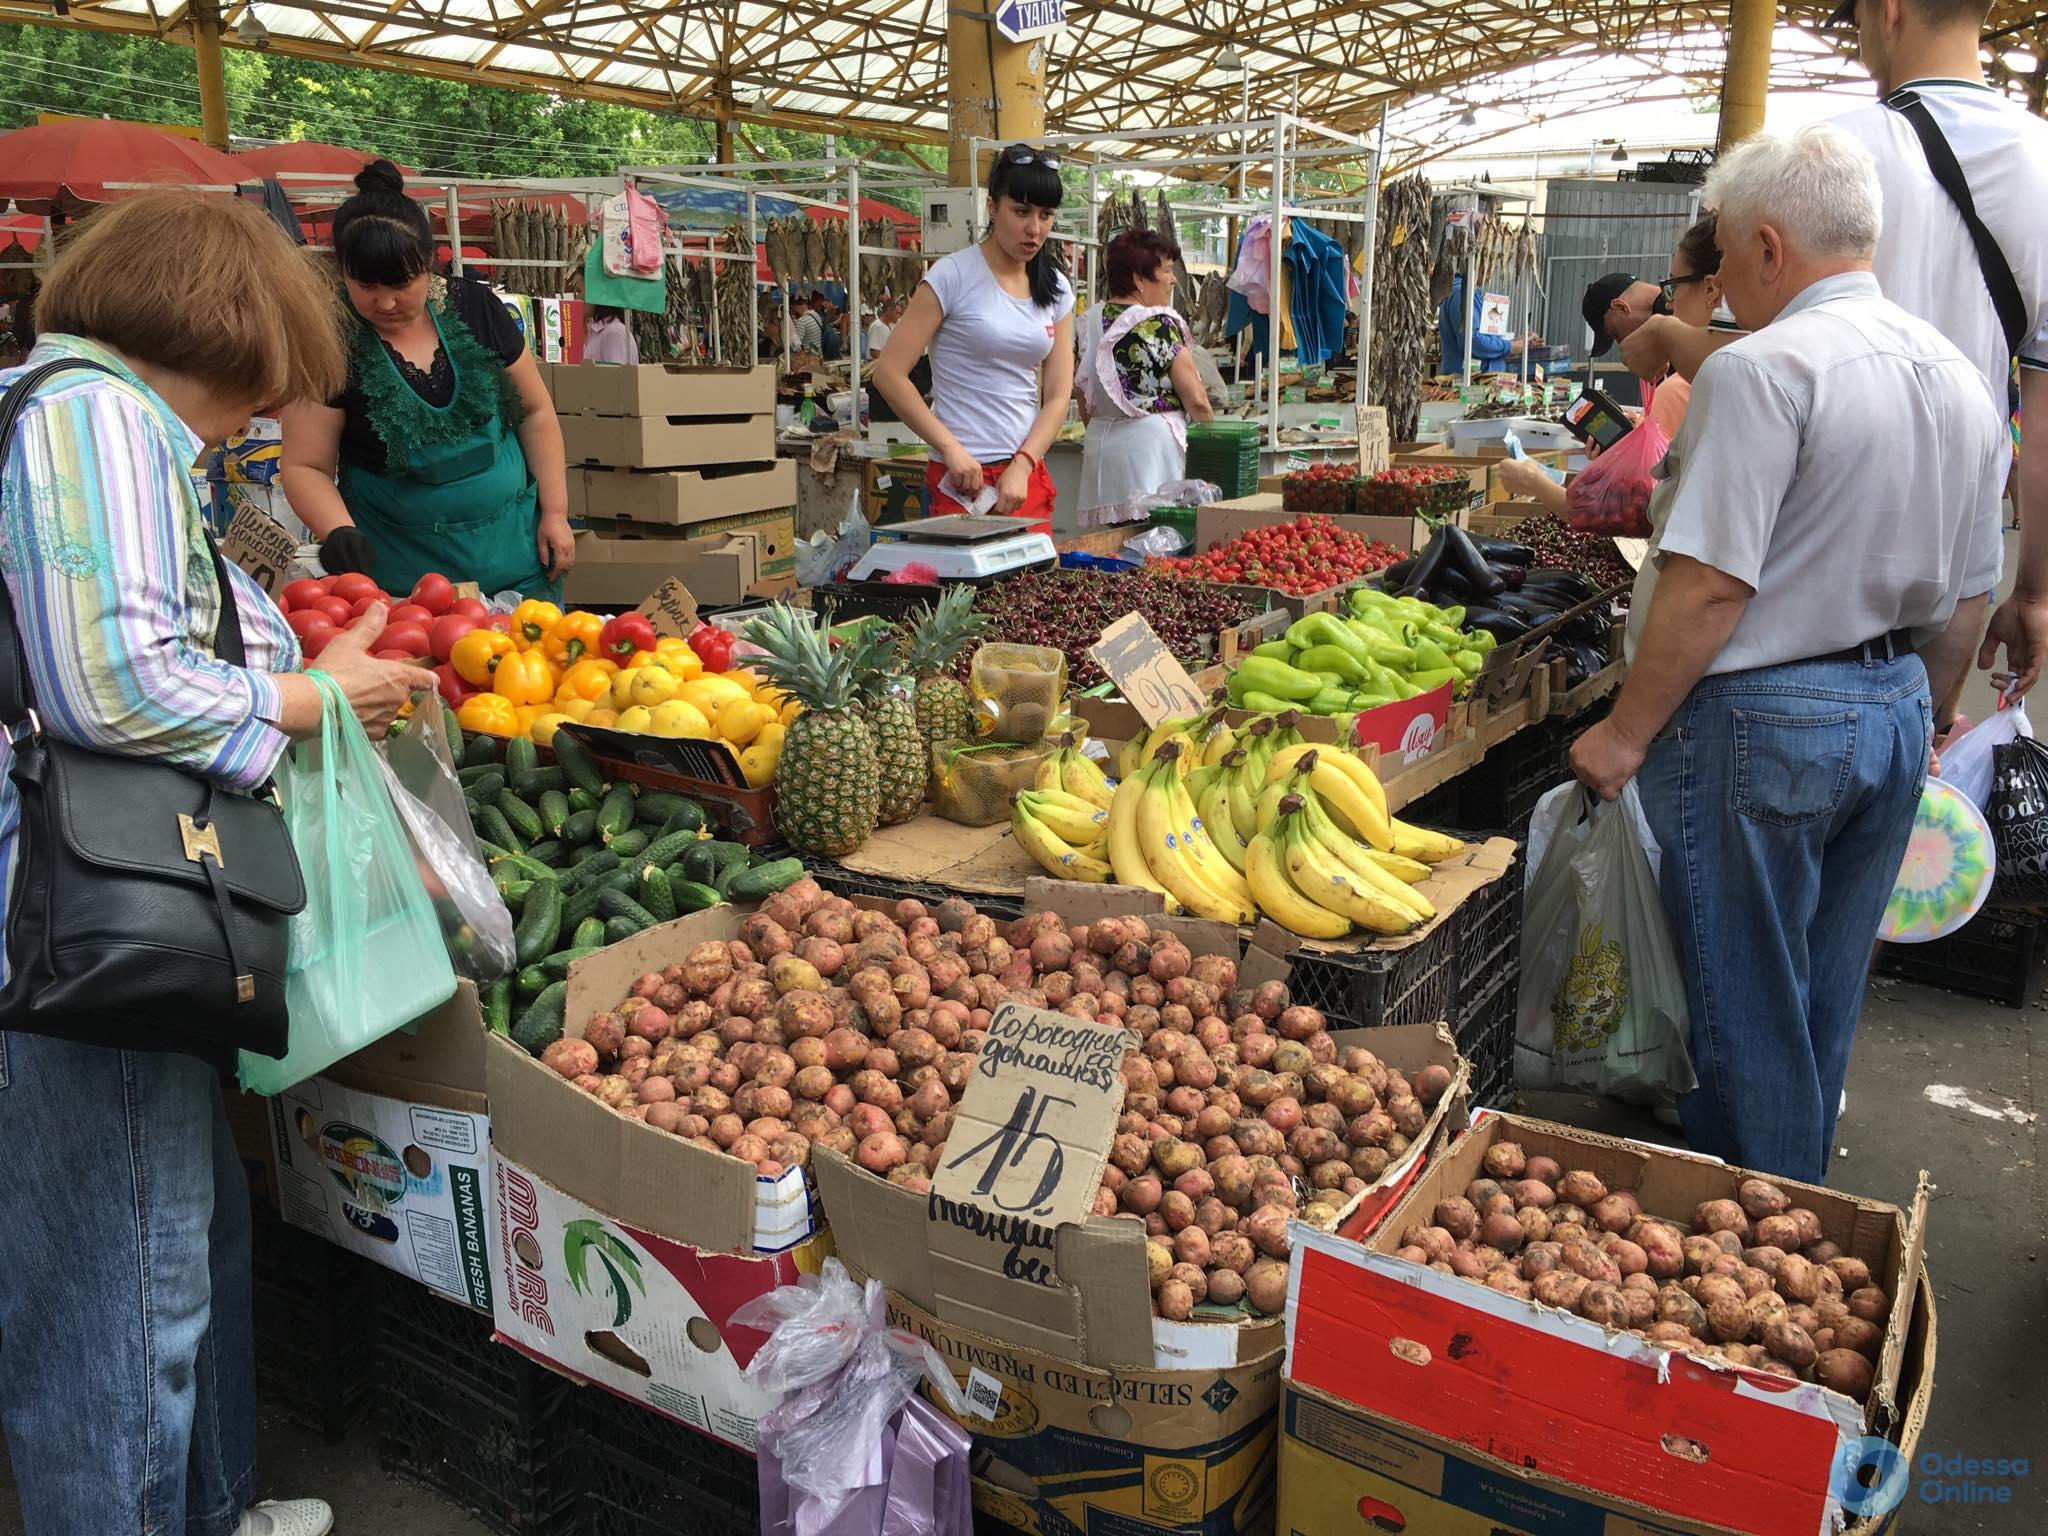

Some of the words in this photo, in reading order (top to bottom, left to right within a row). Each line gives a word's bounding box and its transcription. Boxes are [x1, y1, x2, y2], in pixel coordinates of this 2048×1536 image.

[1016, 0, 1061, 29] ТУАЛЕТ
[946, 1086, 1076, 1213] 15
[496, 1160, 507, 1198] super
[457, 1171, 480, 1253] BANANAS
[498, 1199, 513, 1267] premium
[507, 1167, 556, 1337] MORE
[470, 1255, 489, 1310] FRESH
[502, 1269, 520, 1316] quality
[919, 1322, 1037, 1384] PREMIUM
[1043, 1370, 1194, 1407] SELECTED
[1207, 1384, 1234, 1405] 24
